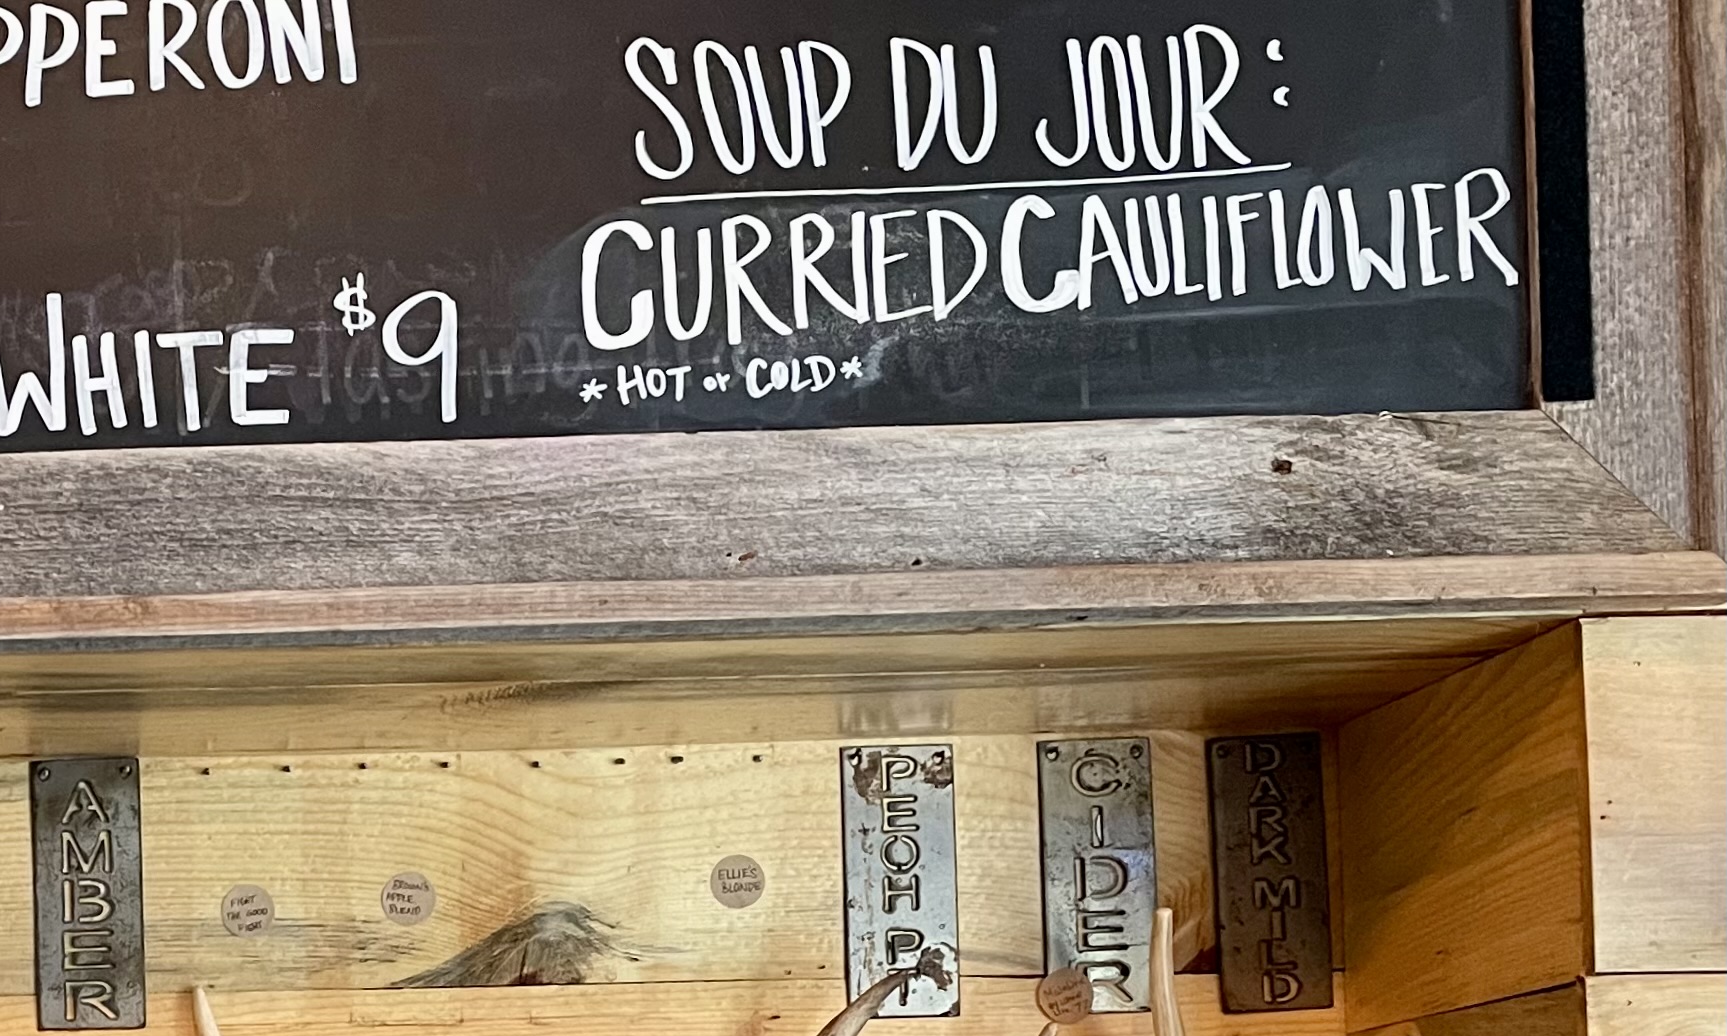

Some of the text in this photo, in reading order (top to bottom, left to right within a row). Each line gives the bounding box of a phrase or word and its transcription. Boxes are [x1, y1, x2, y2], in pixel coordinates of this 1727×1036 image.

[624, 36, 851, 180] SOUP
[890, 36, 997, 171] DU
[333, 272, 459, 423] $9
[581, 209, 988, 350] CURRIED
[1000, 168, 1520, 314] CAULIFLOWER
[703, 372, 731, 392] or
[60, 779, 119, 1023] AMBER
[1071, 748, 1134, 1004] CIDER
[1244, 742, 1303, 1004] DARK MILD
